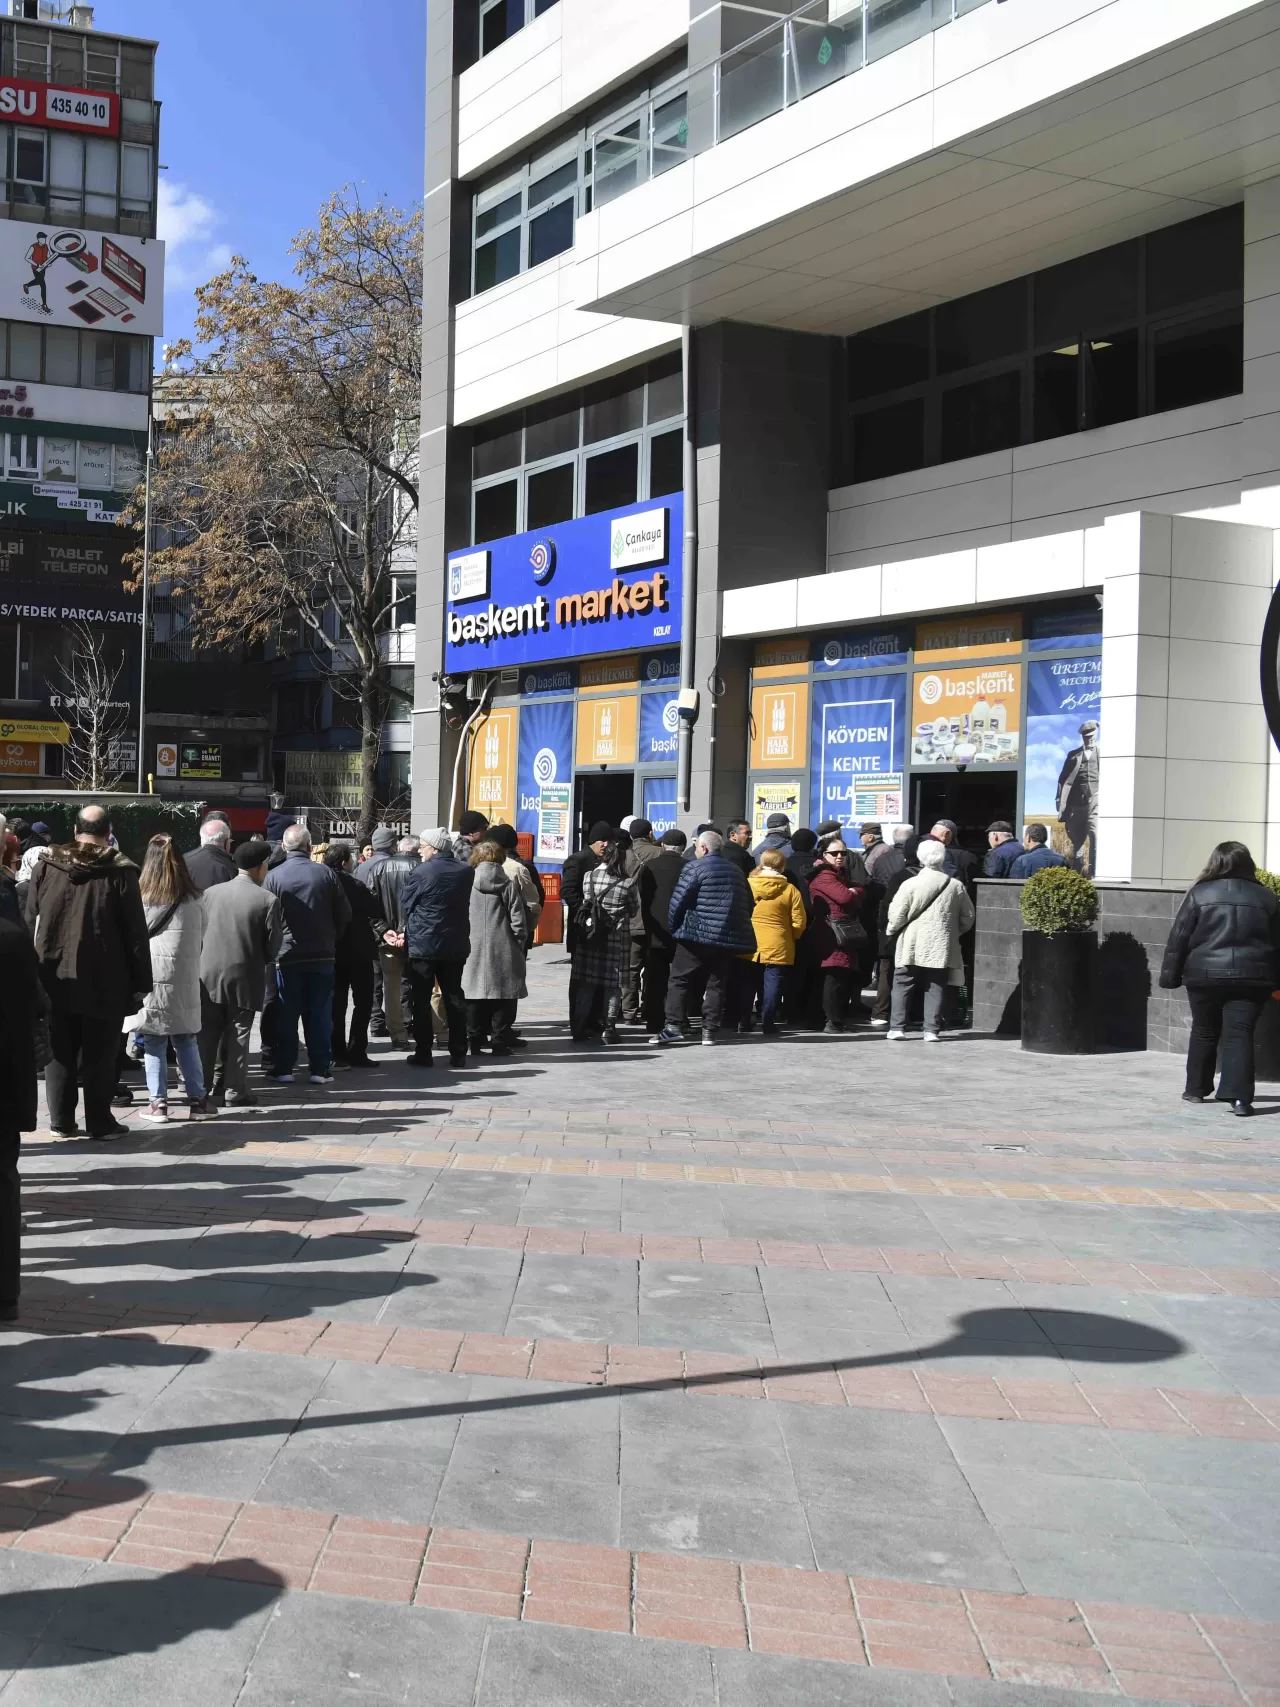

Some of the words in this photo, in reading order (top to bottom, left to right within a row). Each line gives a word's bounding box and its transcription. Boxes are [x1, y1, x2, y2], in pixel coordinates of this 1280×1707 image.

[51, 97, 71, 114] 435
[75, 101, 89, 118] 40
[92, 103, 106, 119] 10
[69, 500, 82, 508] 425
[95, 513, 115, 521] KAT
[625, 529, 662, 547] Çankaya
[48, 547, 103, 561] TABLET
[41, 561, 108, 576] TELEFON
[447, 595, 545, 644] başkent
[556, 572, 665, 625] market
[843, 637, 900, 659] başkent
[924, 636, 955, 650] HALK
[537, 673, 571, 691] başkent
[582, 672, 601, 684] HALK
[608, 668, 635, 681] EKMEK
[981, 671, 1007, 679] MARKET
[945, 673, 1015, 699] başkent
[827, 725, 888, 745] KÖYDEN
[767, 738, 788, 748] HALK
[833, 757, 880, 772] KENTE
[479, 778, 502, 791] HALK
[760, 801, 792, 810] HABERLER
